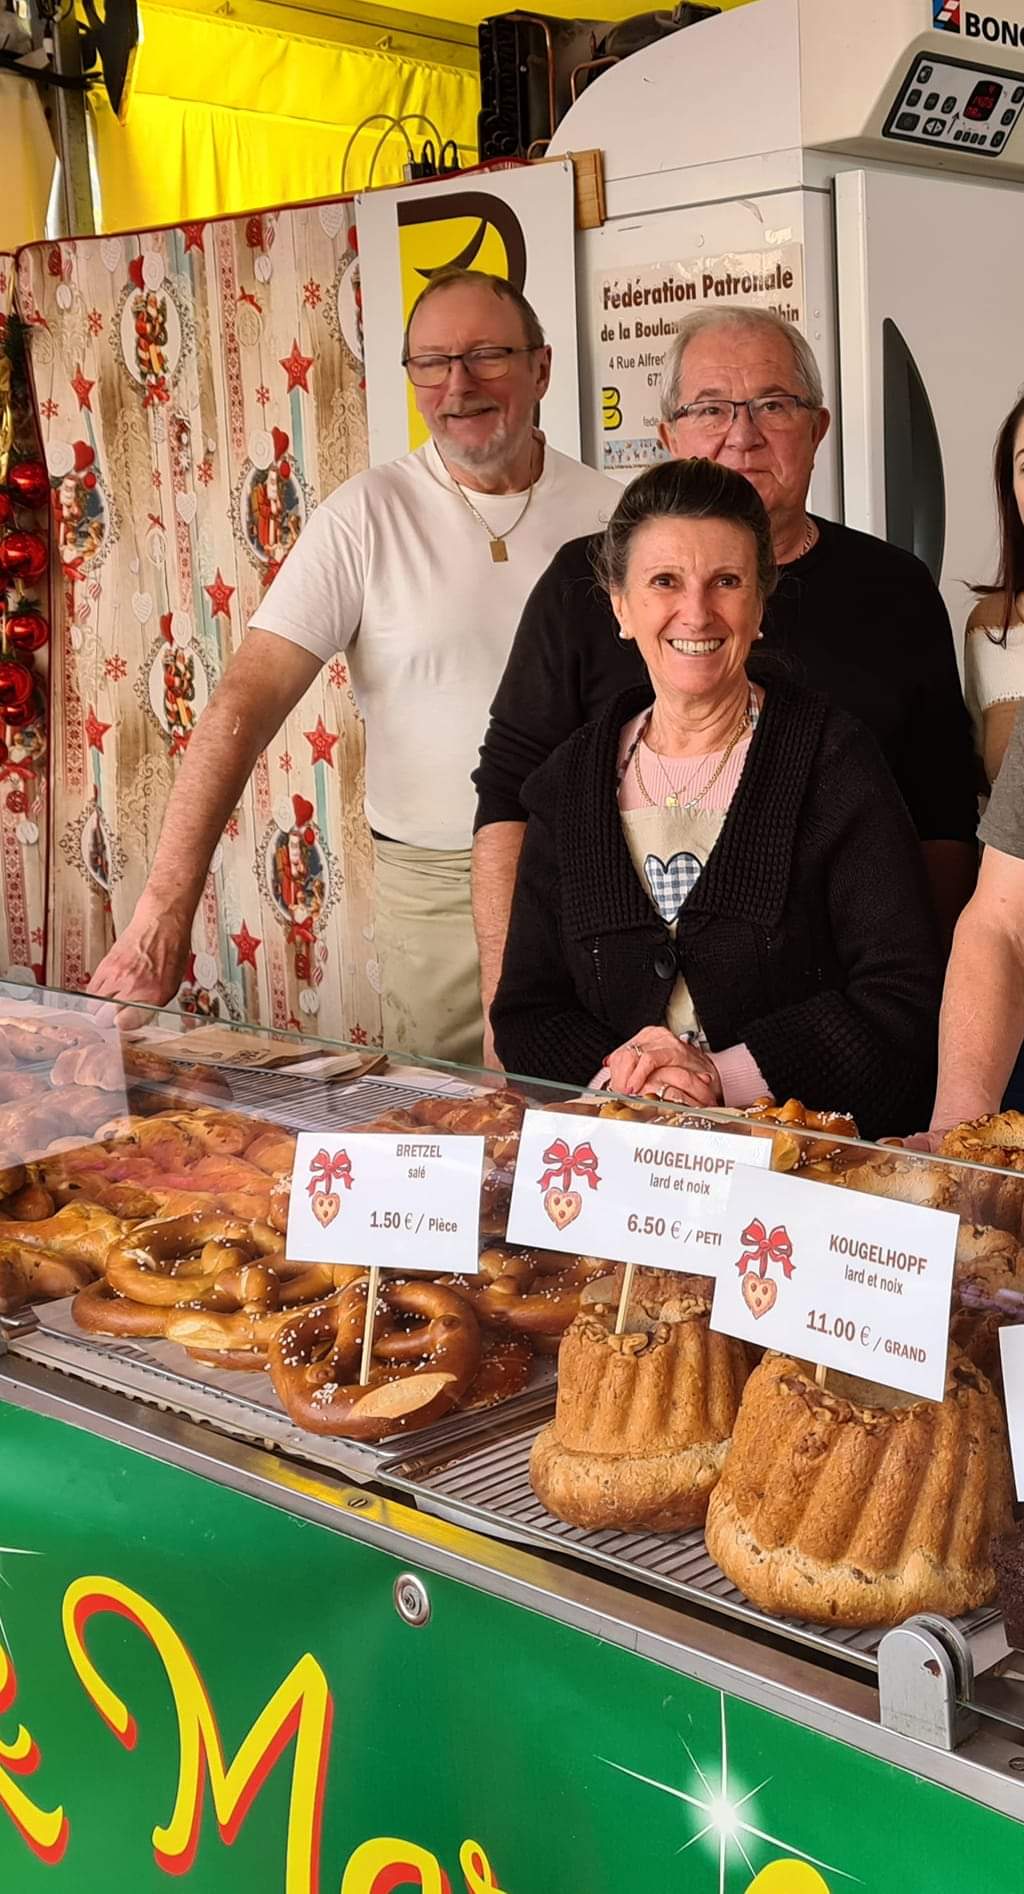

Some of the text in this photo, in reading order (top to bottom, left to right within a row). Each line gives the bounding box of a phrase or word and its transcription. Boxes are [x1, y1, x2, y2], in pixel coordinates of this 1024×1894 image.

[603, 264, 794, 311] Fédération Patronale
[600, 326, 616, 342] de
[618, 323, 631, 340] la
[608, 356, 615, 370] 4
[616, 354, 636, 370] Rue
[396, 1143, 443, 1158] BRETZEL
[633, 1147, 736, 1176] KOUGELHOPF
[407, 1165, 427, 1179] salé
[649, 1173, 711, 1195] lard et noix
[369, 1210, 401, 1229] 1.50
[404, 1212, 413, 1230] €
[428, 1217, 458, 1233] Pièce
[627, 1213, 666, 1237] 6.50
[670, 1220, 682, 1240] €
[829, 1234, 928, 1275] KOUGELHOPF
[844, 1265, 904, 1296] lard et noix
[805, 1309, 856, 1342] 11.00
[860, 1325, 871, 1347] €
[884, 1338, 928, 1364] GRAND
